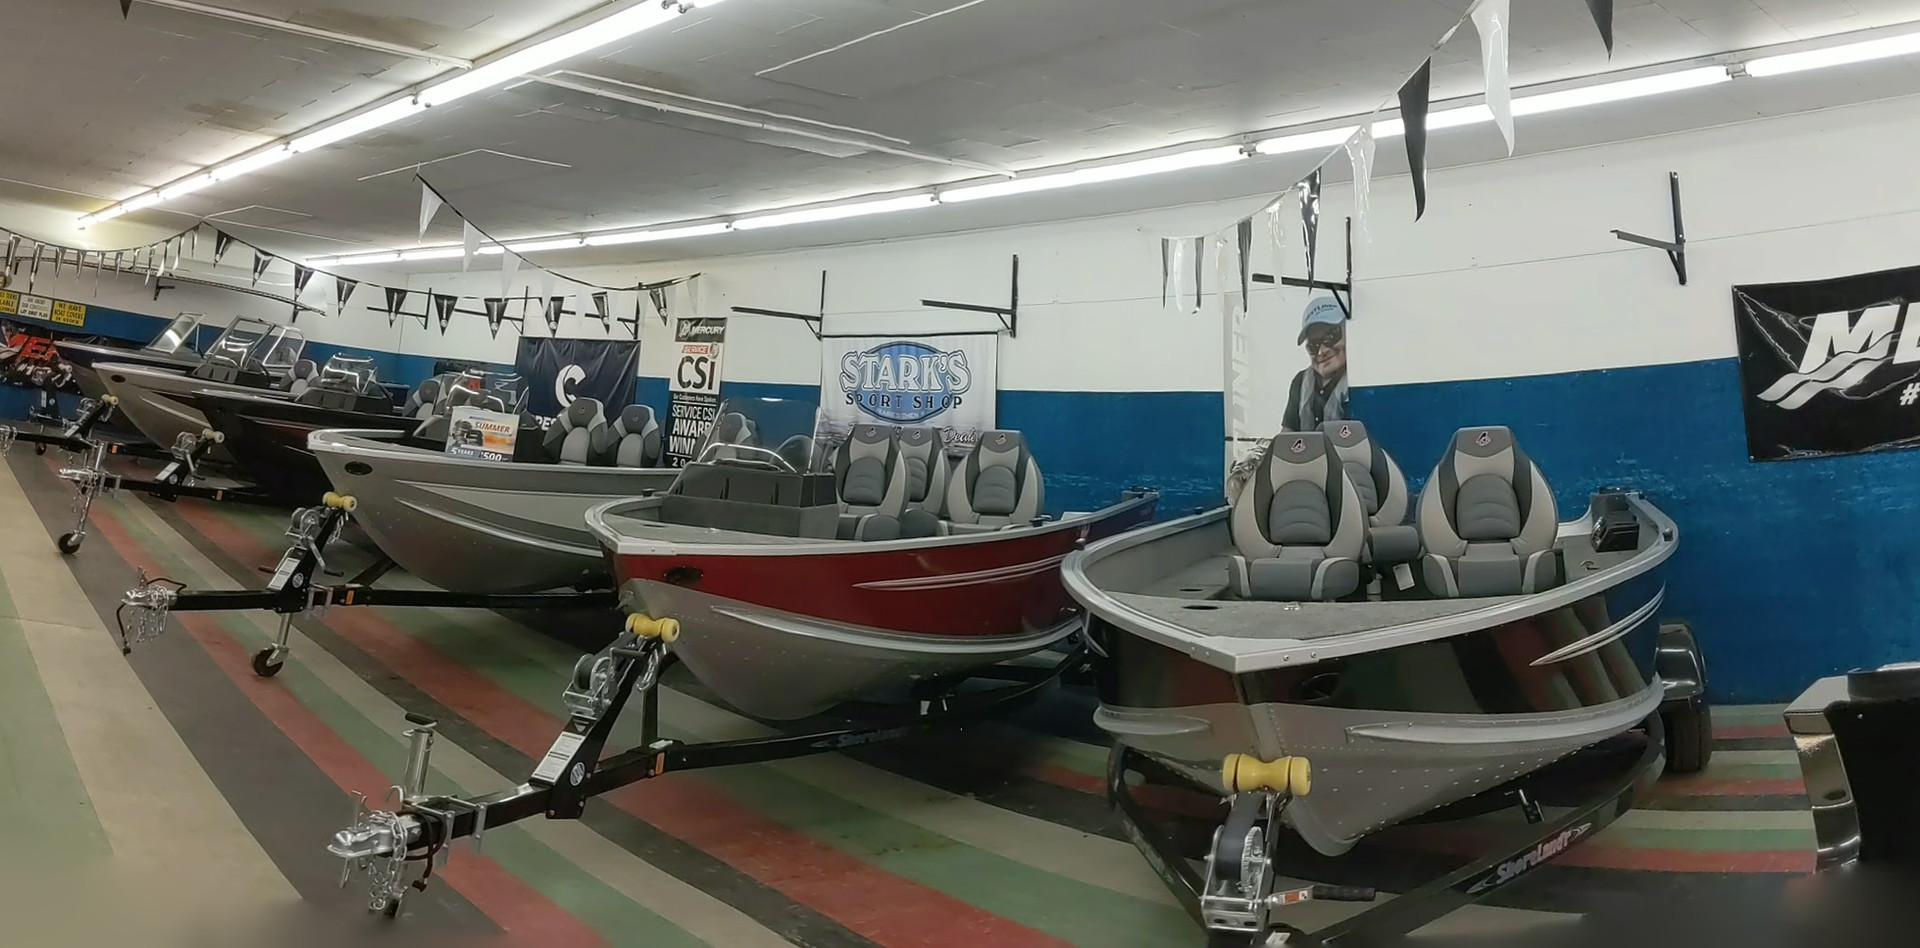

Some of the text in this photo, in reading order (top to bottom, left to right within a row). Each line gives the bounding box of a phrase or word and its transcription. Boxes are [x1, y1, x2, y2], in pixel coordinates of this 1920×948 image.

[690, 325, 725, 336] MERCURY
[684, 346, 708, 354] SERVICE
[677, 355, 716, 390] CSI
[840, 350, 972, 394] STARK'S
[845, 392, 963, 409] SPORT SHOP
[672, 404, 702, 420] SERVICE
[474, 421, 511, 433] SUMMER
[457, 448, 474, 456] YEARS
